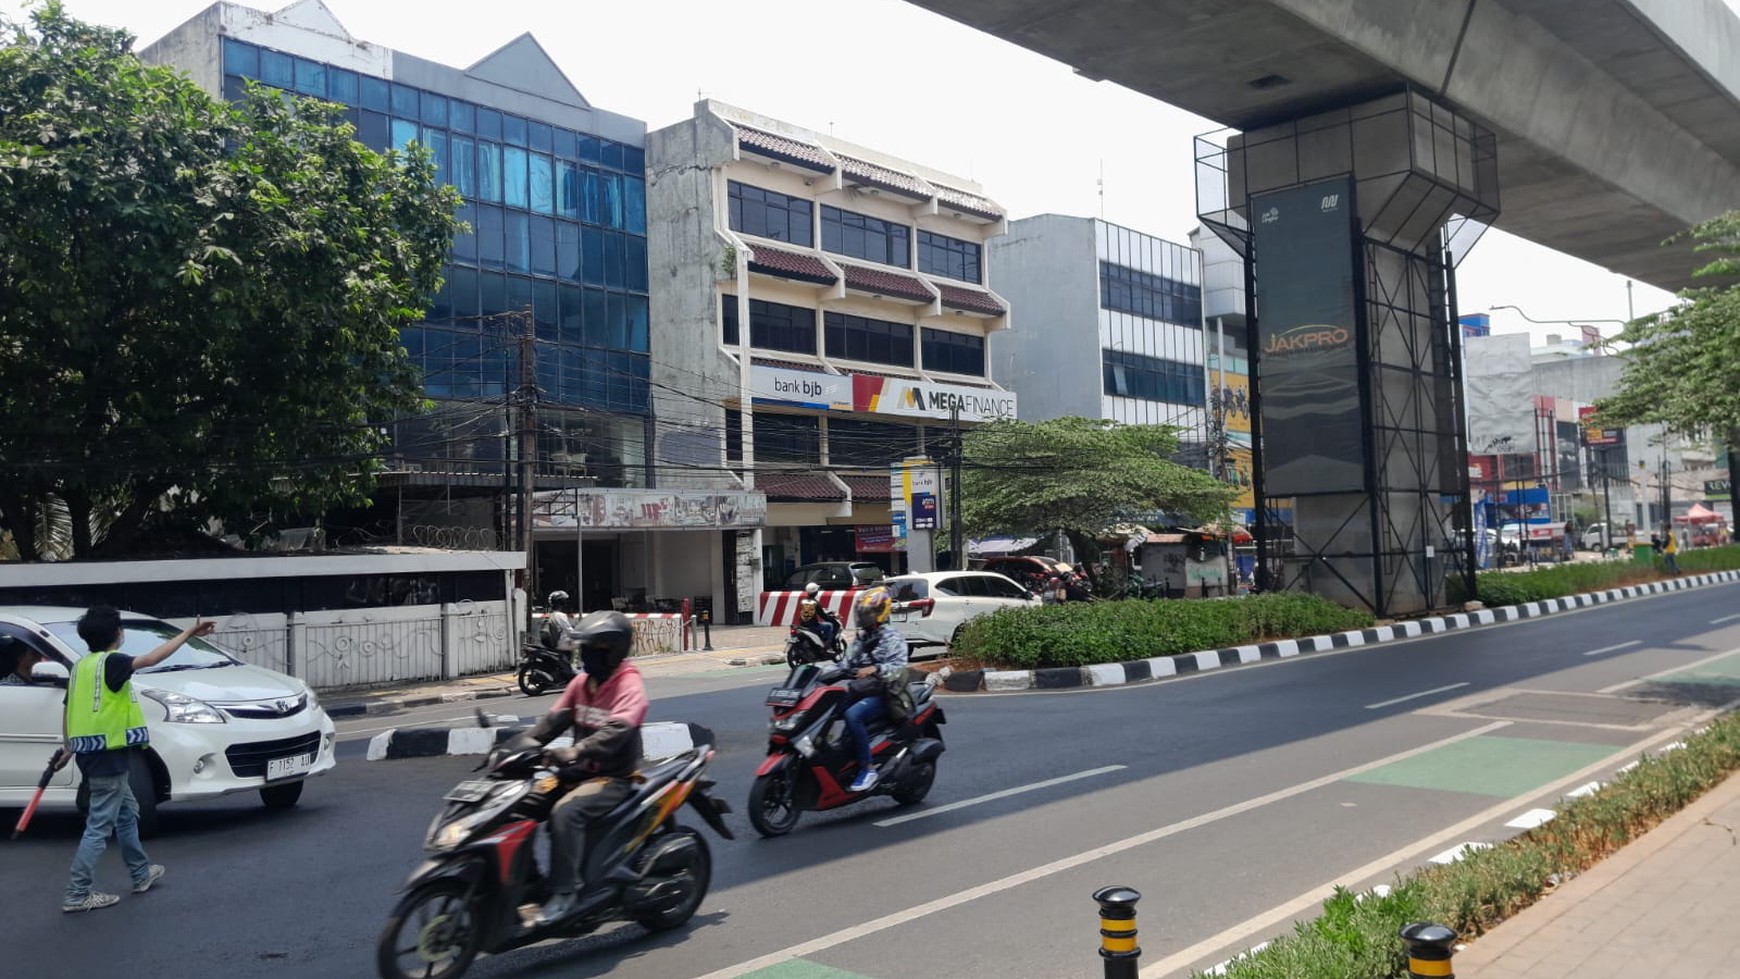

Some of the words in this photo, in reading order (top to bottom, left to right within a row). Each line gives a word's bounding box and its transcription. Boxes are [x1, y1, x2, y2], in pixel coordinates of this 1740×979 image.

[1264, 328, 1348, 352] JAKPRO
[774, 376, 800, 393] bank
[802, 379, 822, 396] bjb
